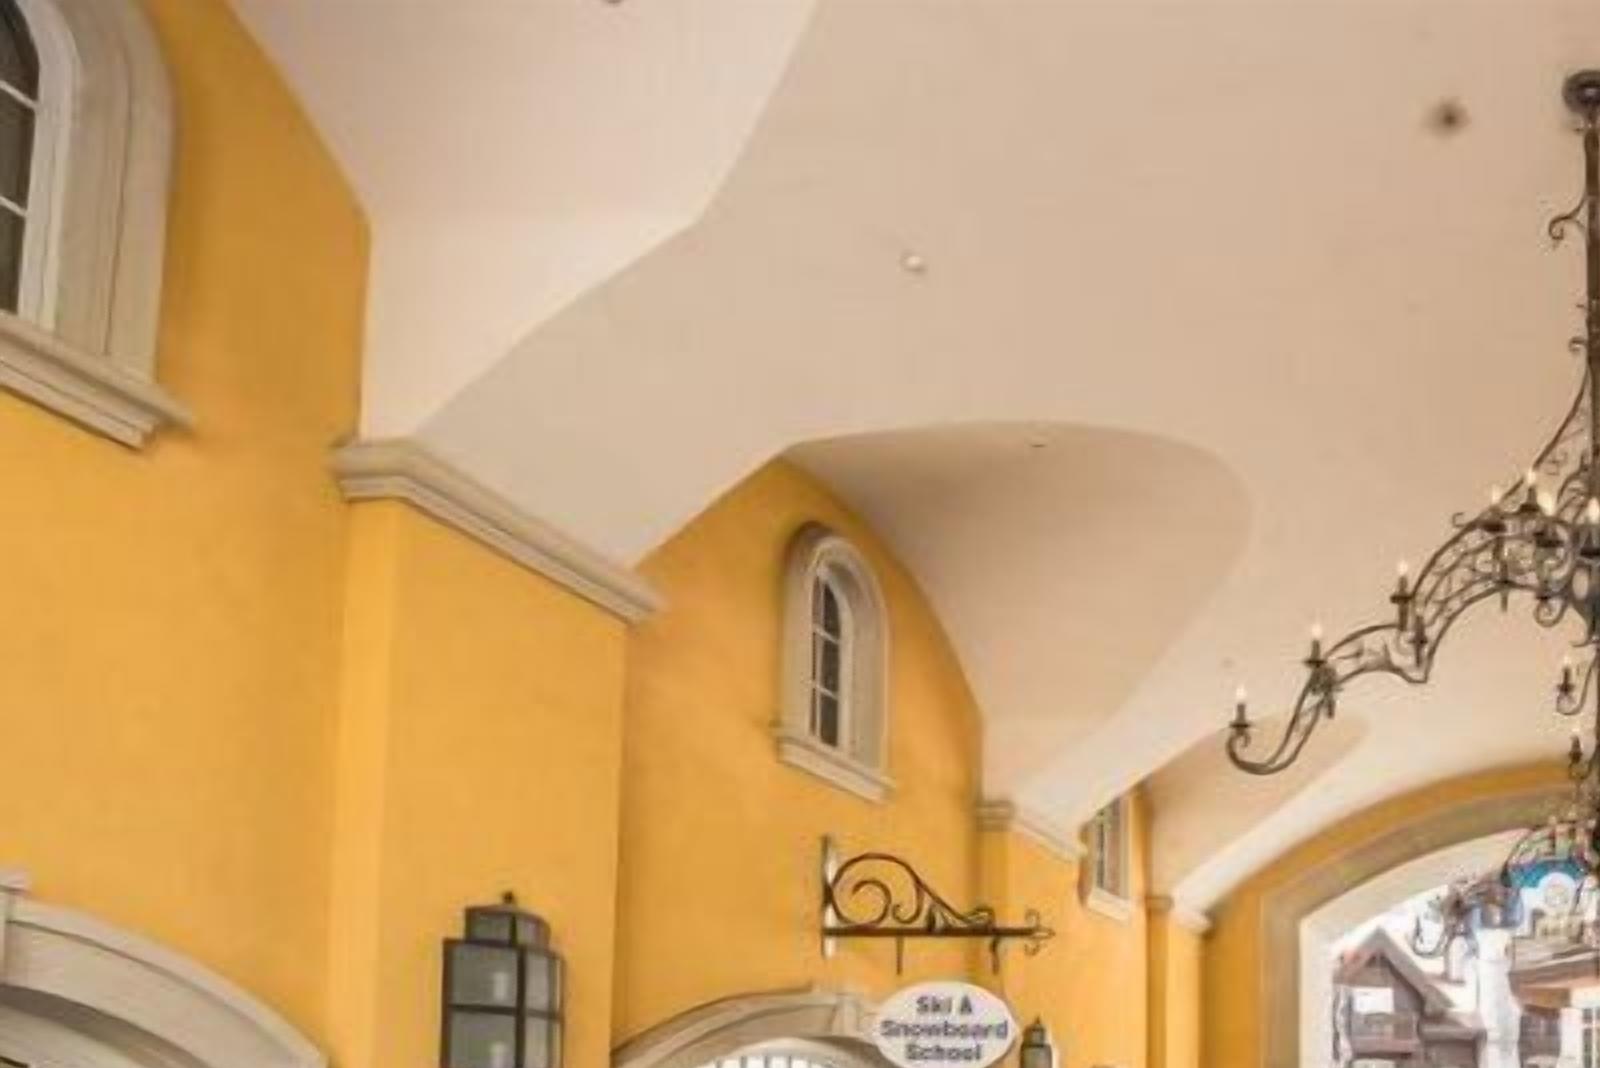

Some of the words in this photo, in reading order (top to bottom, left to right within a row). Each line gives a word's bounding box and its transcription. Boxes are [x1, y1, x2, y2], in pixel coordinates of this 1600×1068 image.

[916, 995, 953, 1014] Ski
[880, 1019, 1009, 1039] Snowboard
[906, 1043, 982, 1060] School
